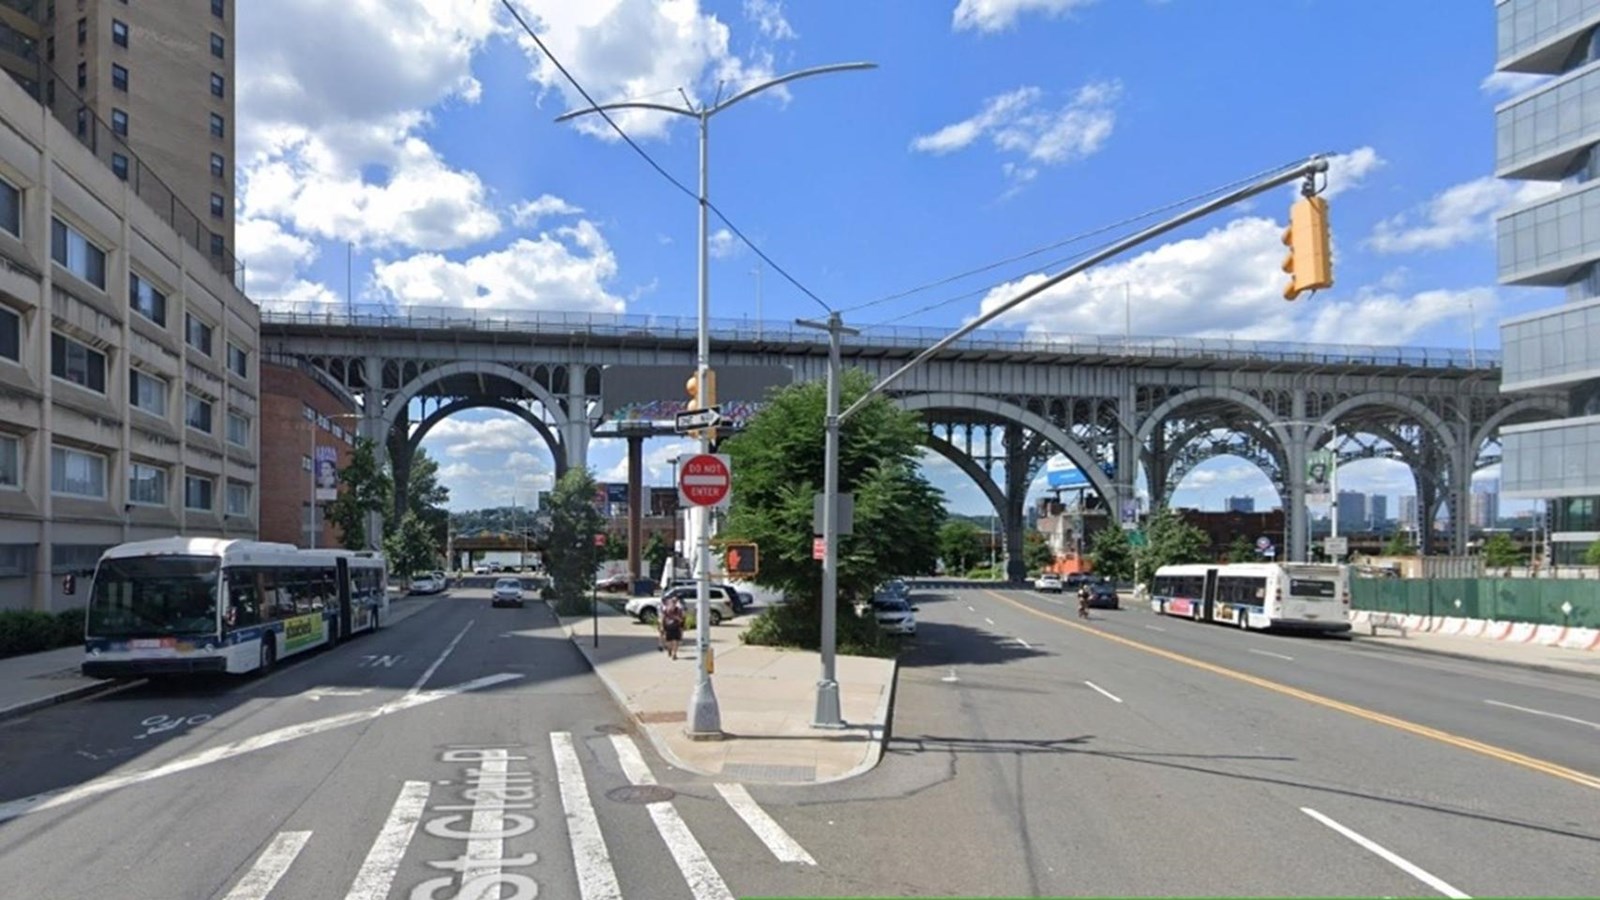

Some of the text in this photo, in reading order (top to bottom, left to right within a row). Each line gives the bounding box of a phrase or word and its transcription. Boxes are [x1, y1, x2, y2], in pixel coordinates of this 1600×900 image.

[689, 464, 721, 473] DO NOT
[691, 487, 720, 496] ENTER
